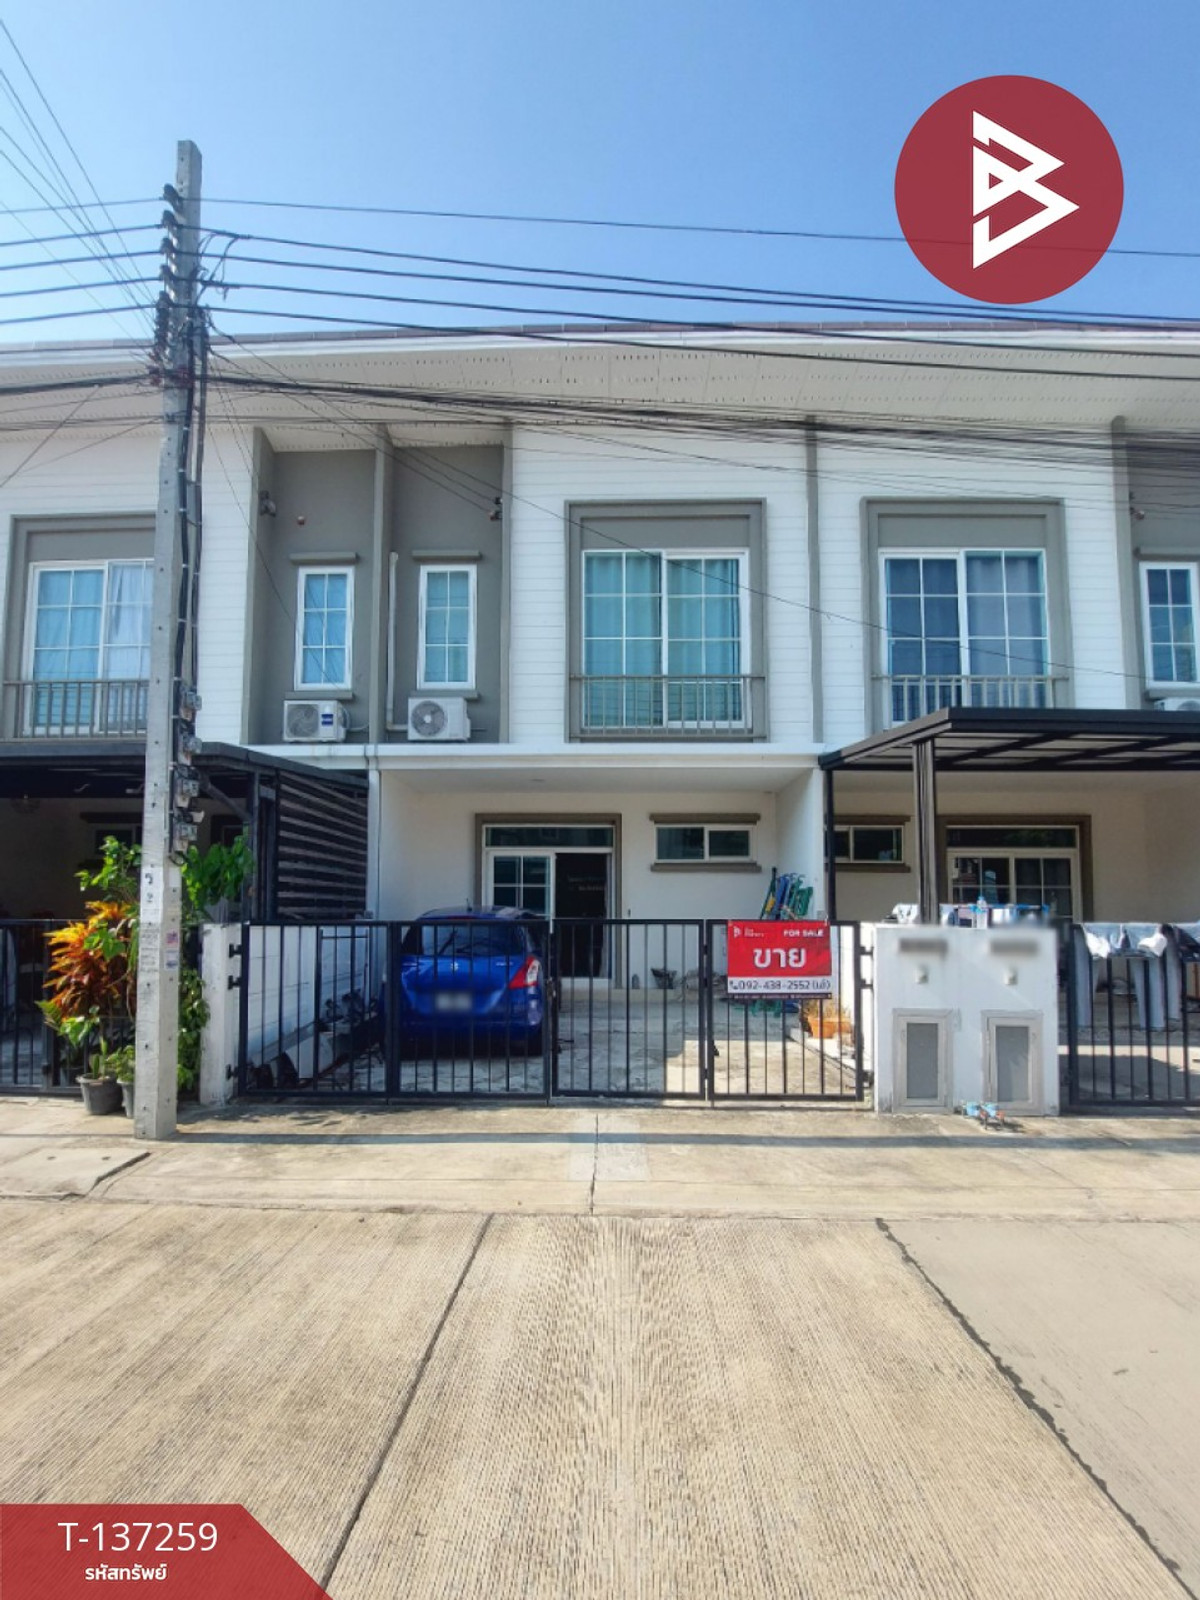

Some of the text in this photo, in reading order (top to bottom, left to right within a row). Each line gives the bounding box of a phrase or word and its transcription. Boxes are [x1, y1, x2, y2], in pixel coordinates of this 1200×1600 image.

[783, 928, 824, 937] FOR SALE
[753, 948, 806, 968] ขาย
